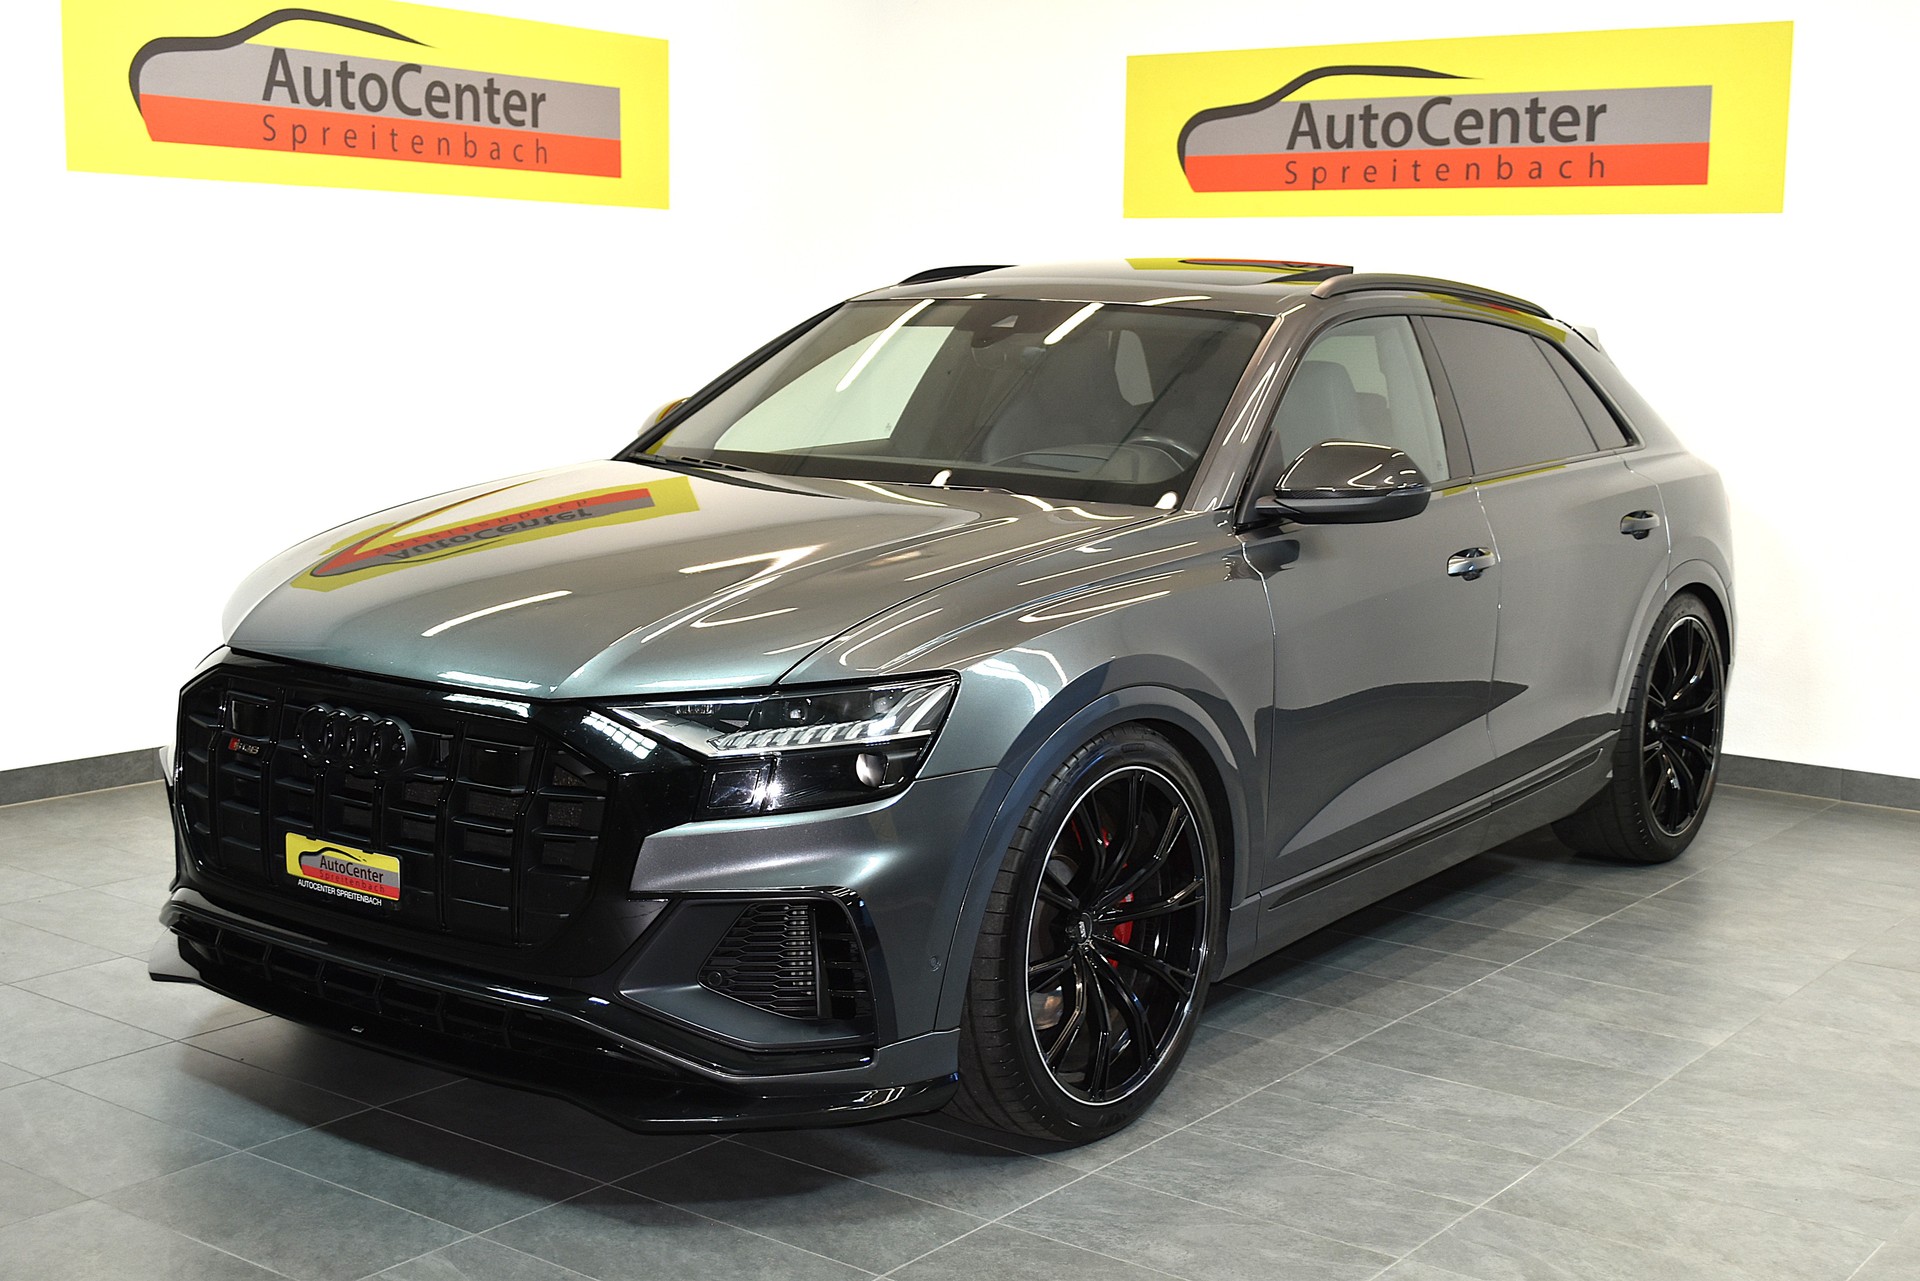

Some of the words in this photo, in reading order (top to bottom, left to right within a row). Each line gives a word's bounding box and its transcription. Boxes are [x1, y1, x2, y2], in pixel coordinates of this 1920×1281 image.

[262, 47, 547, 128] AutoCenter
[262, 113, 549, 165] Spreitenbach
[1286, 96, 1607, 150] AutoCenter
[1284, 153, 1606, 190] Spreitenbach
[319, 855, 384, 883] AutoCenter
[319, 869, 385, 893] Spreitenbach
[297, 878, 336, 896] AUTOCENTER
[336, 888, 382, 906] SPREITENBACH
